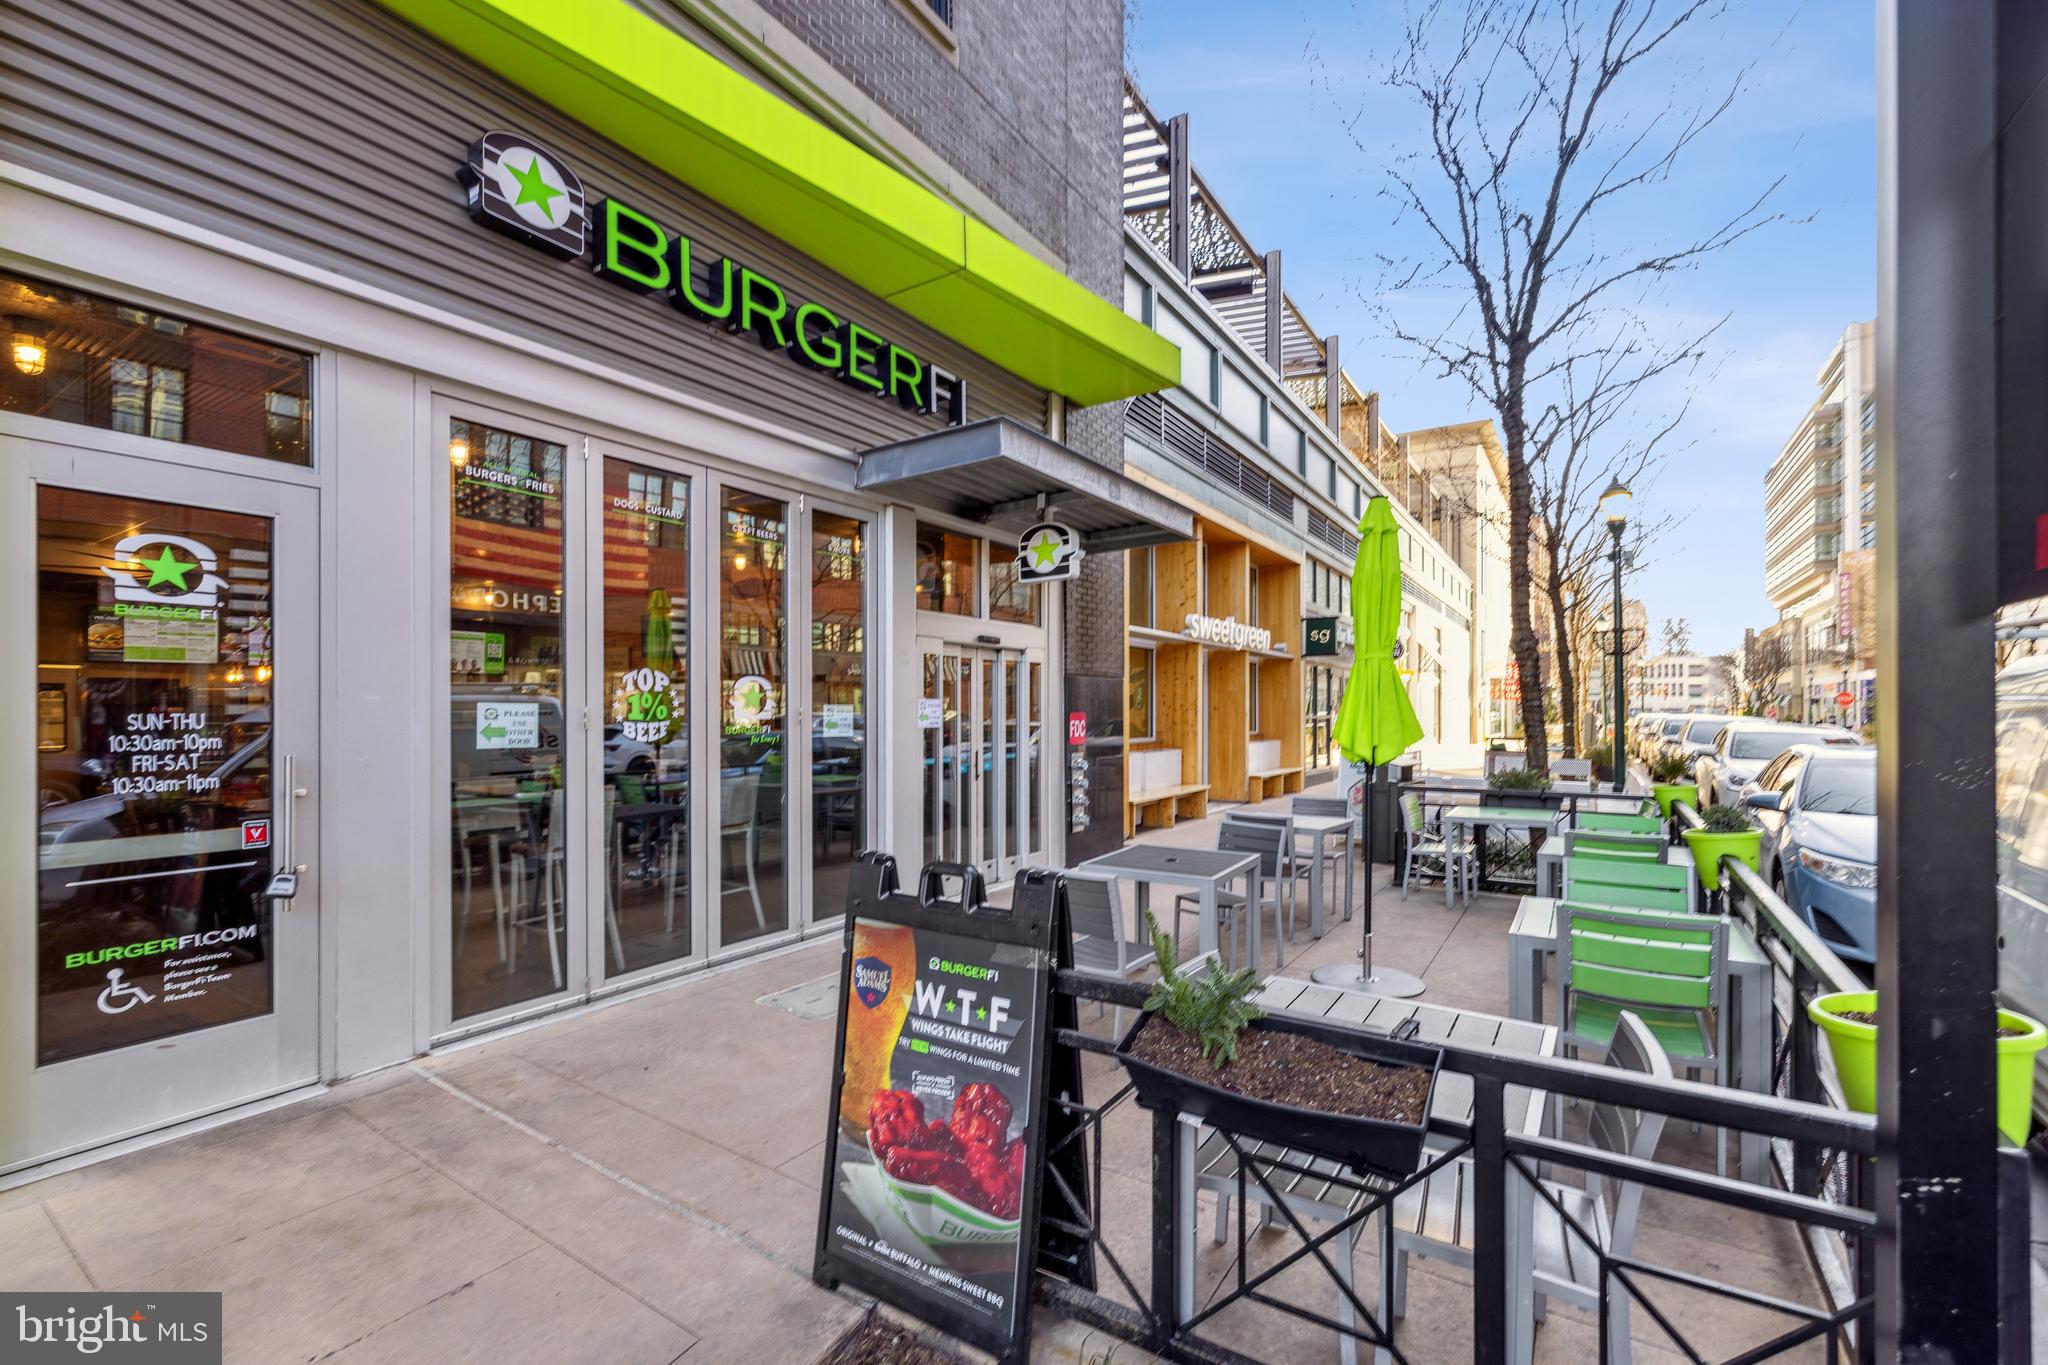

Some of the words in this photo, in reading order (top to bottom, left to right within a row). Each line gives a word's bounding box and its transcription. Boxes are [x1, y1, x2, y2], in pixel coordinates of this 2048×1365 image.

[604, 196, 968, 426] BURGERFI
[465, 465, 518, 486] BURGERS
[525, 479, 555, 494] FRIES
[613, 497, 640, 511] DOGS
[645, 504, 683, 519] CUSTARD
[732, 523, 755, 537] CRAFT
[756, 528, 778, 541] BEERS
[113, 603, 219, 620] BURGERFI
[1188, 613, 1271, 651] sweetgreen
[1310, 628, 1331, 644] sg
[622, 667, 670, 692] TOP
[627, 691, 668, 721] 1%
[127, 713, 206, 731] SUN-THU
[622, 720, 671, 743] BEEF
[724, 723, 771, 735] BURGERFI
[1069, 719, 1086, 738] FDC
[108, 733, 223, 752] 10:30am-10pm
[132, 753, 200, 773] FRI-SAT
[112, 774, 220, 795] 10:30am-11pm
[65, 924, 257, 969] BURGERFI.COM
[164, 958, 181, 968] For
[855, 963, 891, 984] SAMUEL
[940, 960, 999, 983] BURGERFI
[164, 969, 194, 982] please
[857, 976, 888, 993] ADAMS
[911, 1018, 945, 1038] WINGS
[944, 1026, 970, 1045] TAKE
[970, 1032, 1010, 1054] FLIGHT
[899, 1036, 911, 1048] TRY
[929, 1044, 952, 1059] WINGS
[951, 1049, 968, 1062] FOR
[967, 1054, 974, 1065] A
[973, 1056, 1003, 1072] LIMITED
[1002, 1063, 1021, 1077] TIME
[836, 1224, 868, 1247] ORIGINAL
[890, 1247, 922, 1270] BUFFALO
[928, 1264, 963, 1289] MEMPHIS
[962, 1279, 988, 1299] SWEET
[986, 1290, 1005, 1309] BBQ
